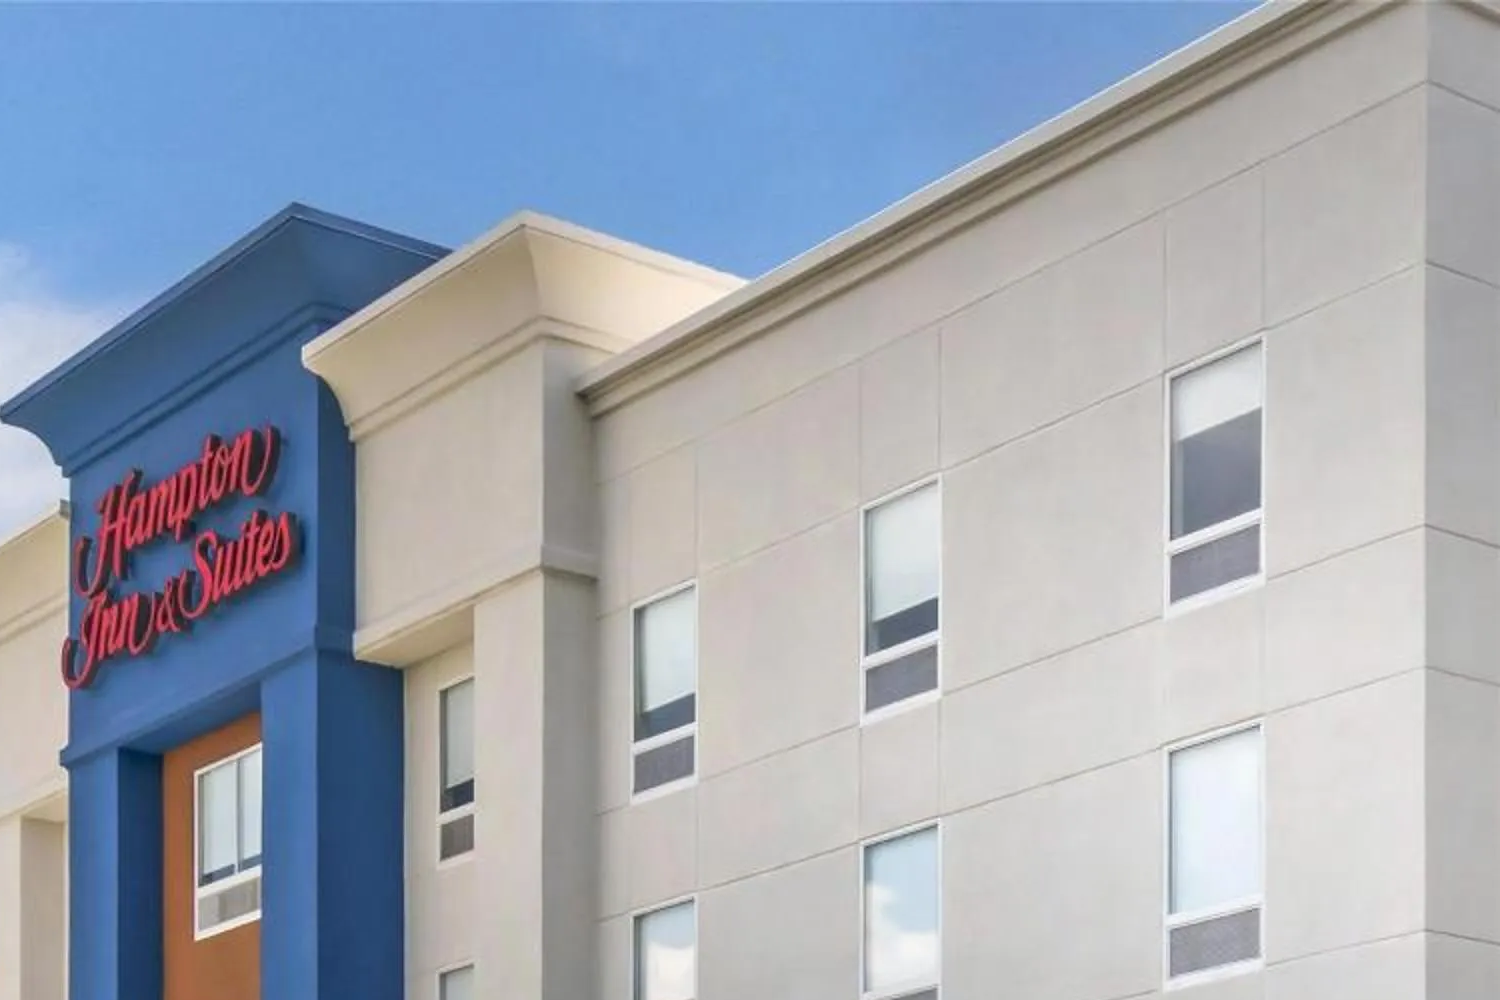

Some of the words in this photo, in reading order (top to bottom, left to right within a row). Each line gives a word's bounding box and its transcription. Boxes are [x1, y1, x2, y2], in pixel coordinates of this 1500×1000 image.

[73, 424, 275, 597] Hampton
[62, 592, 156, 689] Inn
[156, 575, 181, 632] &
[179, 511, 293, 619] Suites
